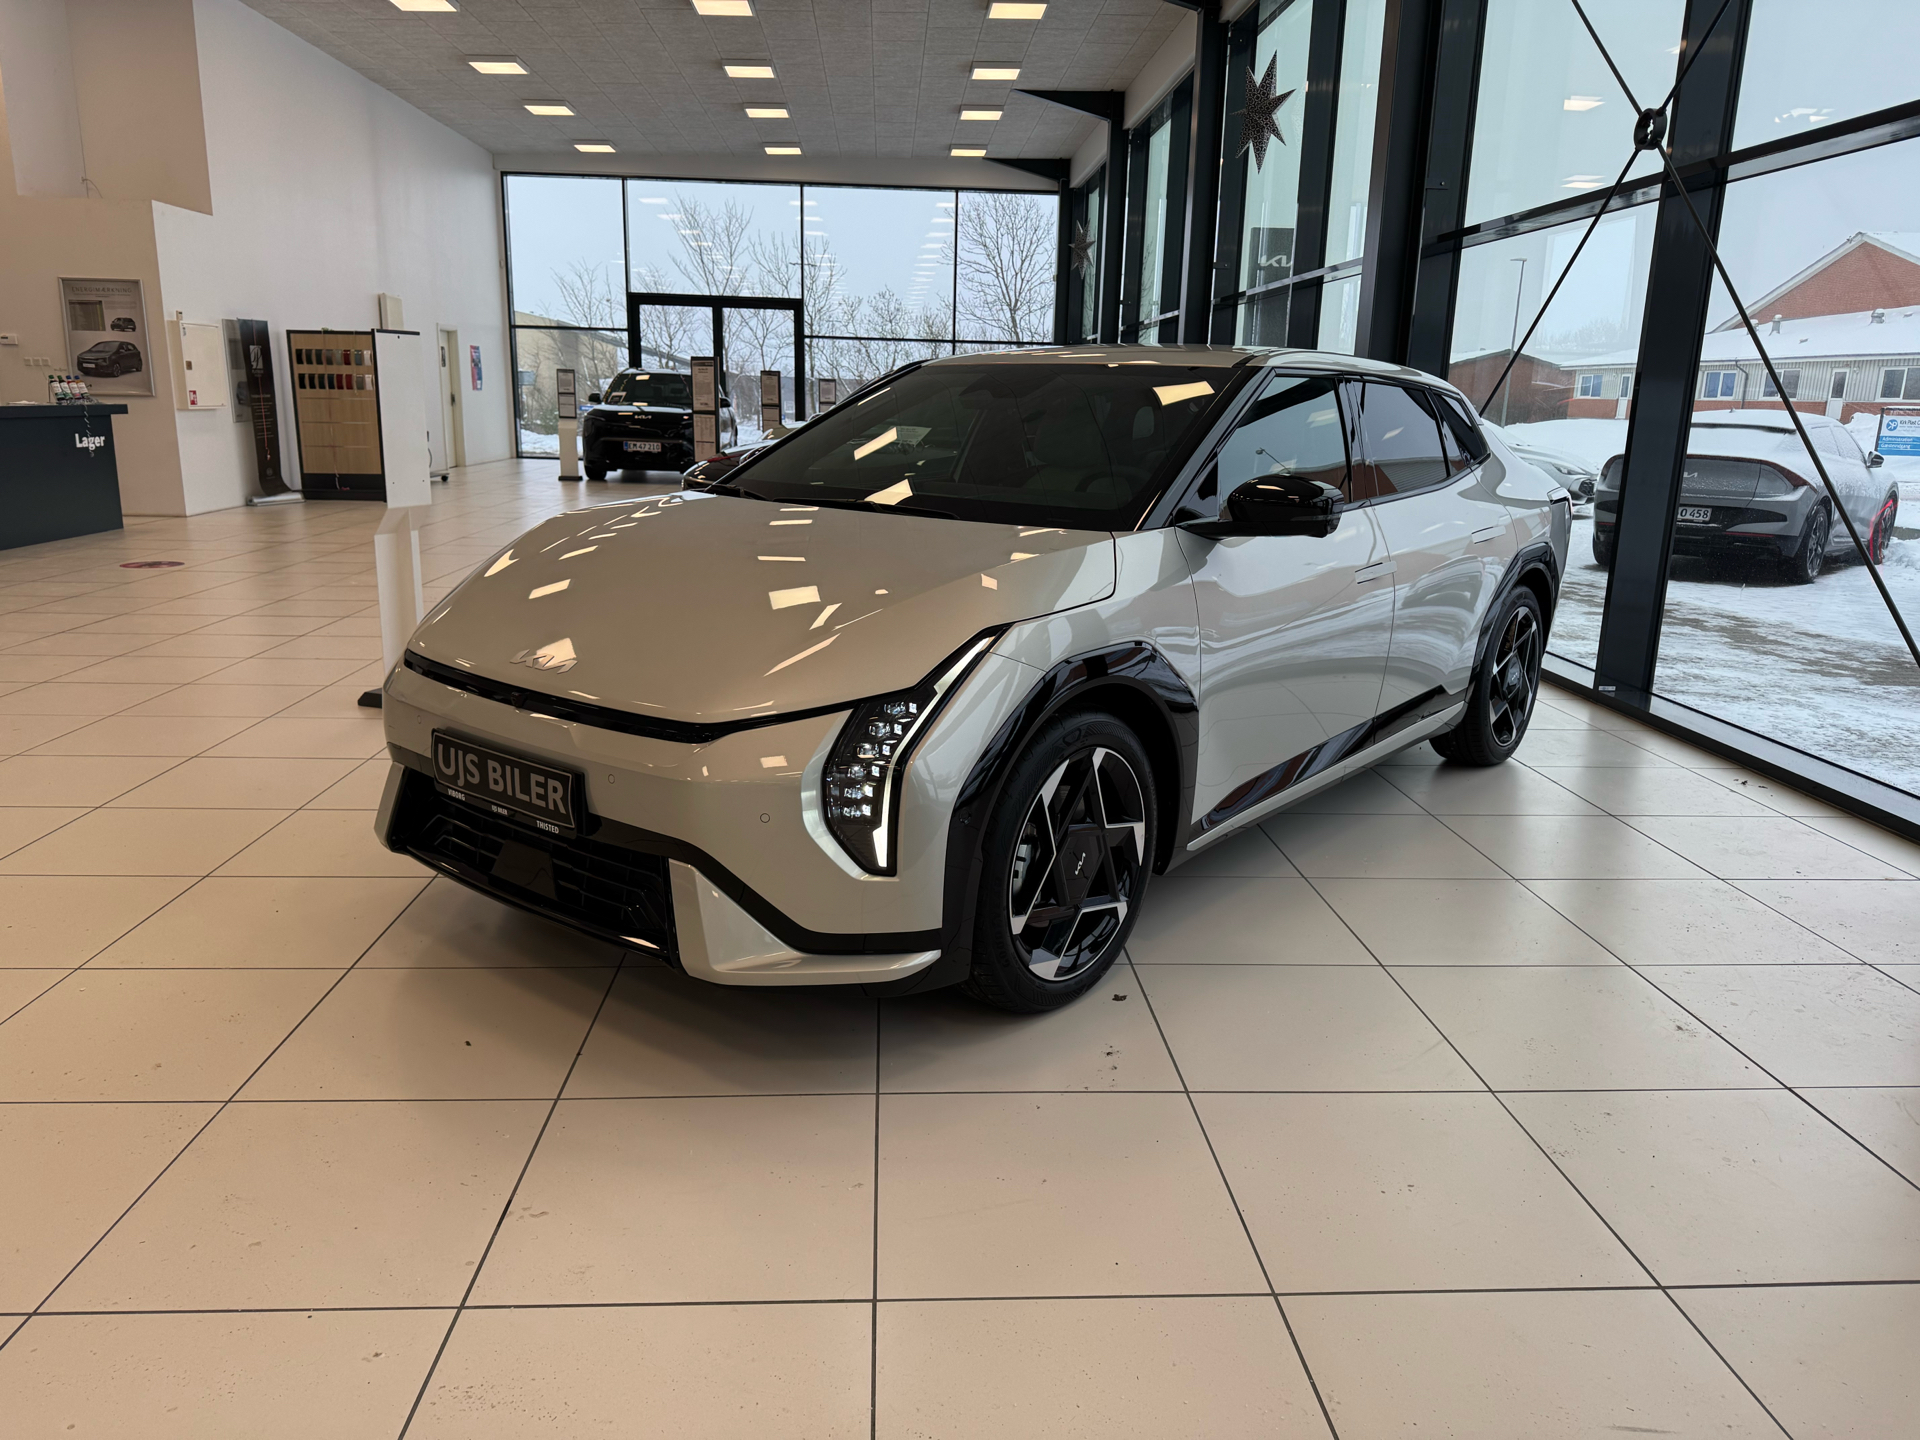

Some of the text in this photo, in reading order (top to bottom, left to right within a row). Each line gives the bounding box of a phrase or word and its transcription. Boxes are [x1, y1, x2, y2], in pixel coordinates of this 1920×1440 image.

[75, 433, 105, 450] Lager
[1689, 509, 1709, 519] 458
[438, 743, 567, 815] UJS BILER
[447, 788, 466, 801] VIBORG
[536, 820, 559, 834] THISTED
